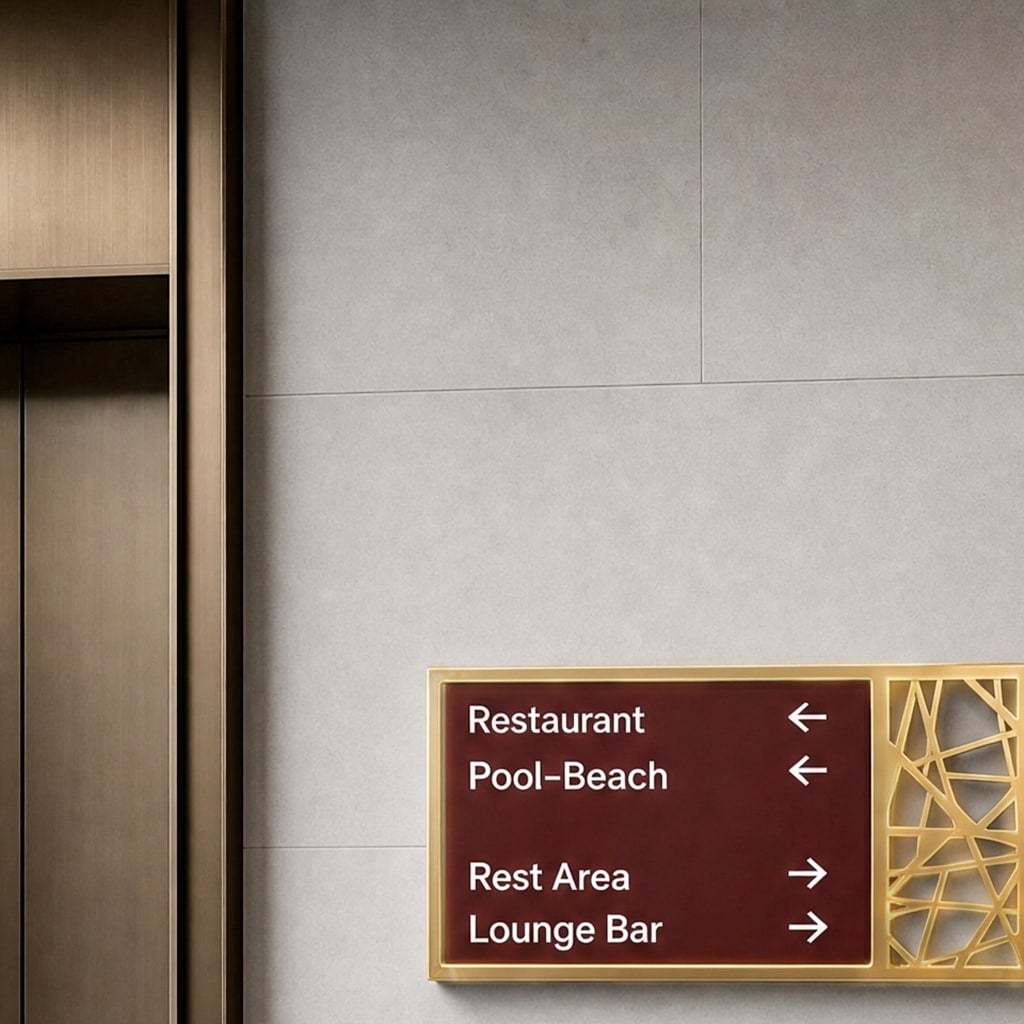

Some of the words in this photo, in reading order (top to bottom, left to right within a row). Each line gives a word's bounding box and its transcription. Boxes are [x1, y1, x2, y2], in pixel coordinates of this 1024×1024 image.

[469, 705, 646, 734] Restaurant
[469, 861, 543, 891] Rest
[551, 862, 630, 891] Area
[469, 914, 596, 952] Lounge
[606, 914, 664, 944] Bar
